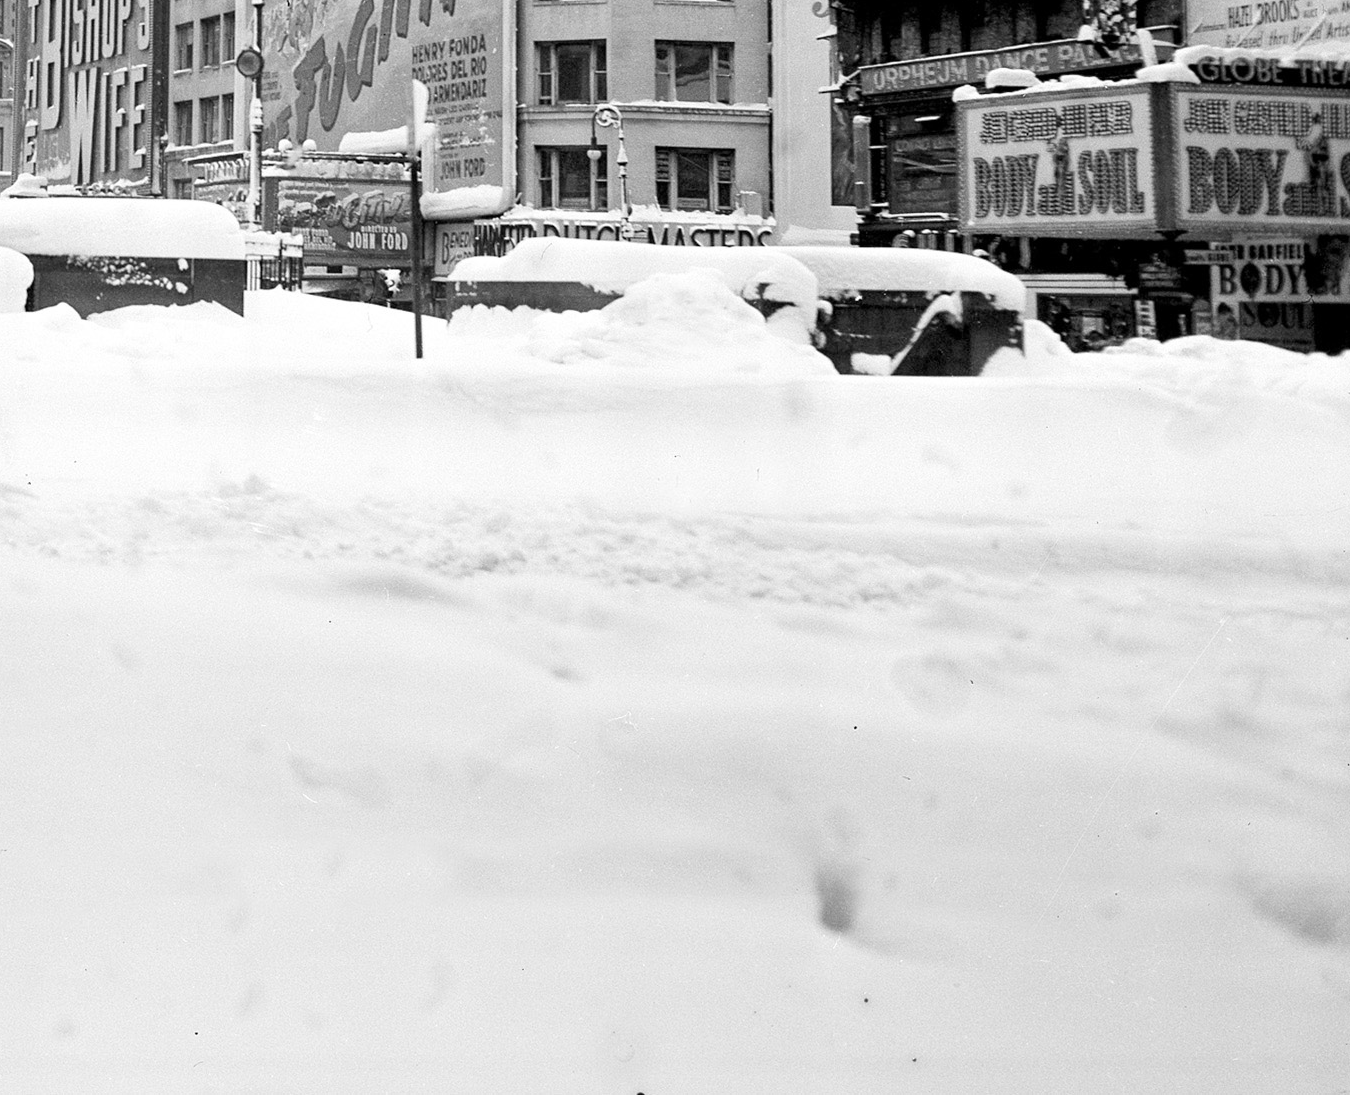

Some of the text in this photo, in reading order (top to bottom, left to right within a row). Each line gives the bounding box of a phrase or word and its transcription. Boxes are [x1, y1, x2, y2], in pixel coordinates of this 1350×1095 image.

[412, 33, 487, 65] HENRY FONDA
[411, 56, 487, 84] DOLORES DEL RIO
[872, 56, 967, 90] ORPHEUM
[1197, 55, 1283, 84] GLOBE
[433, 78, 487, 104] ARMENDARIZ
[68, 66, 148, 186] WIFE
[439, 157, 486, 181] JOHN FORD
[973, 153, 1040, 218] BODY
[1077, 148, 1146, 216] SOUL
[1186, 146, 1290, 216] BODY
[347, 231, 376, 250] JOHN
[381, 232, 409, 251] FORD
[1220, 262, 1306, 297] BODY
